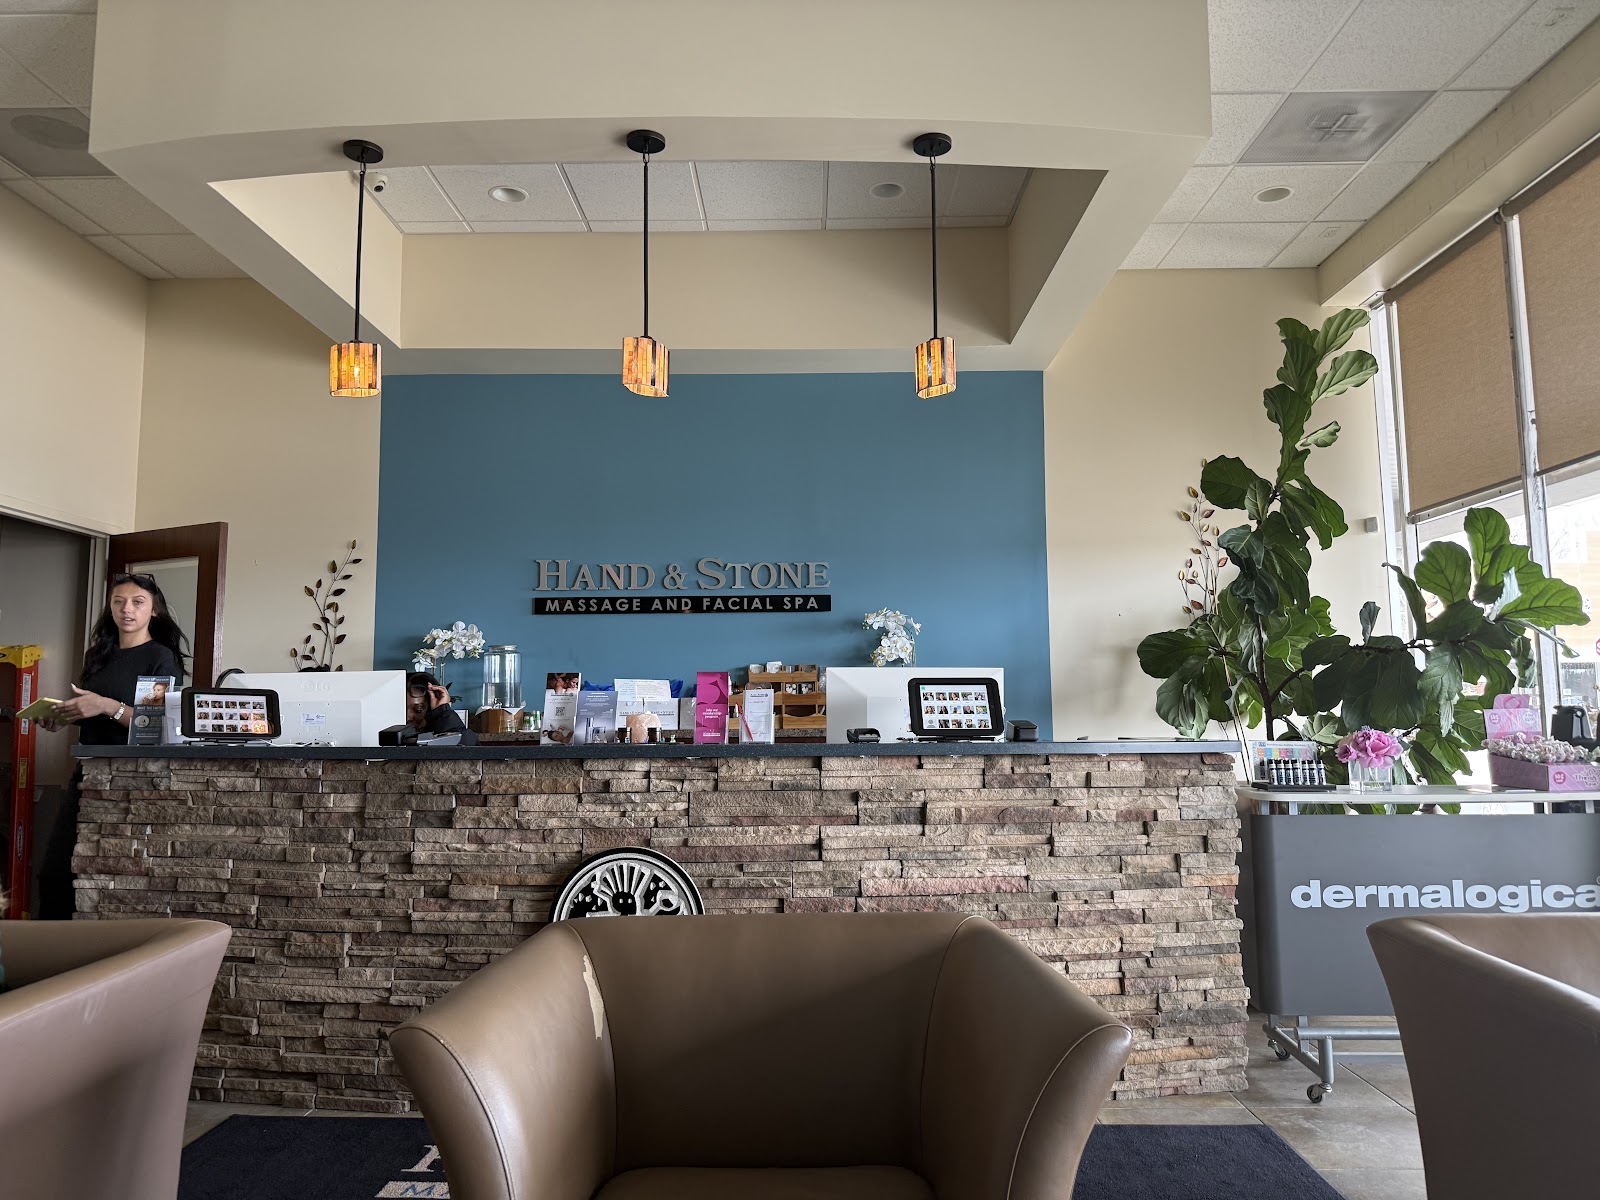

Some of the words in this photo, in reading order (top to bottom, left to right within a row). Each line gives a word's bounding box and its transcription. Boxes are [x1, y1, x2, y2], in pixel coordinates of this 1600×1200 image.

[534, 559, 655, 591] HAND
[663, 563, 688, 590] &
[697, 557, 831, 590] STONE
[545, 598, 641, 612] MASSAGE
[651, 598, 692, 611] AND
[702, 597, 773, 611] FACIAL
[783, 596, 819, 610] SPA
[1290, 879, 1600, 913] dermalogica
